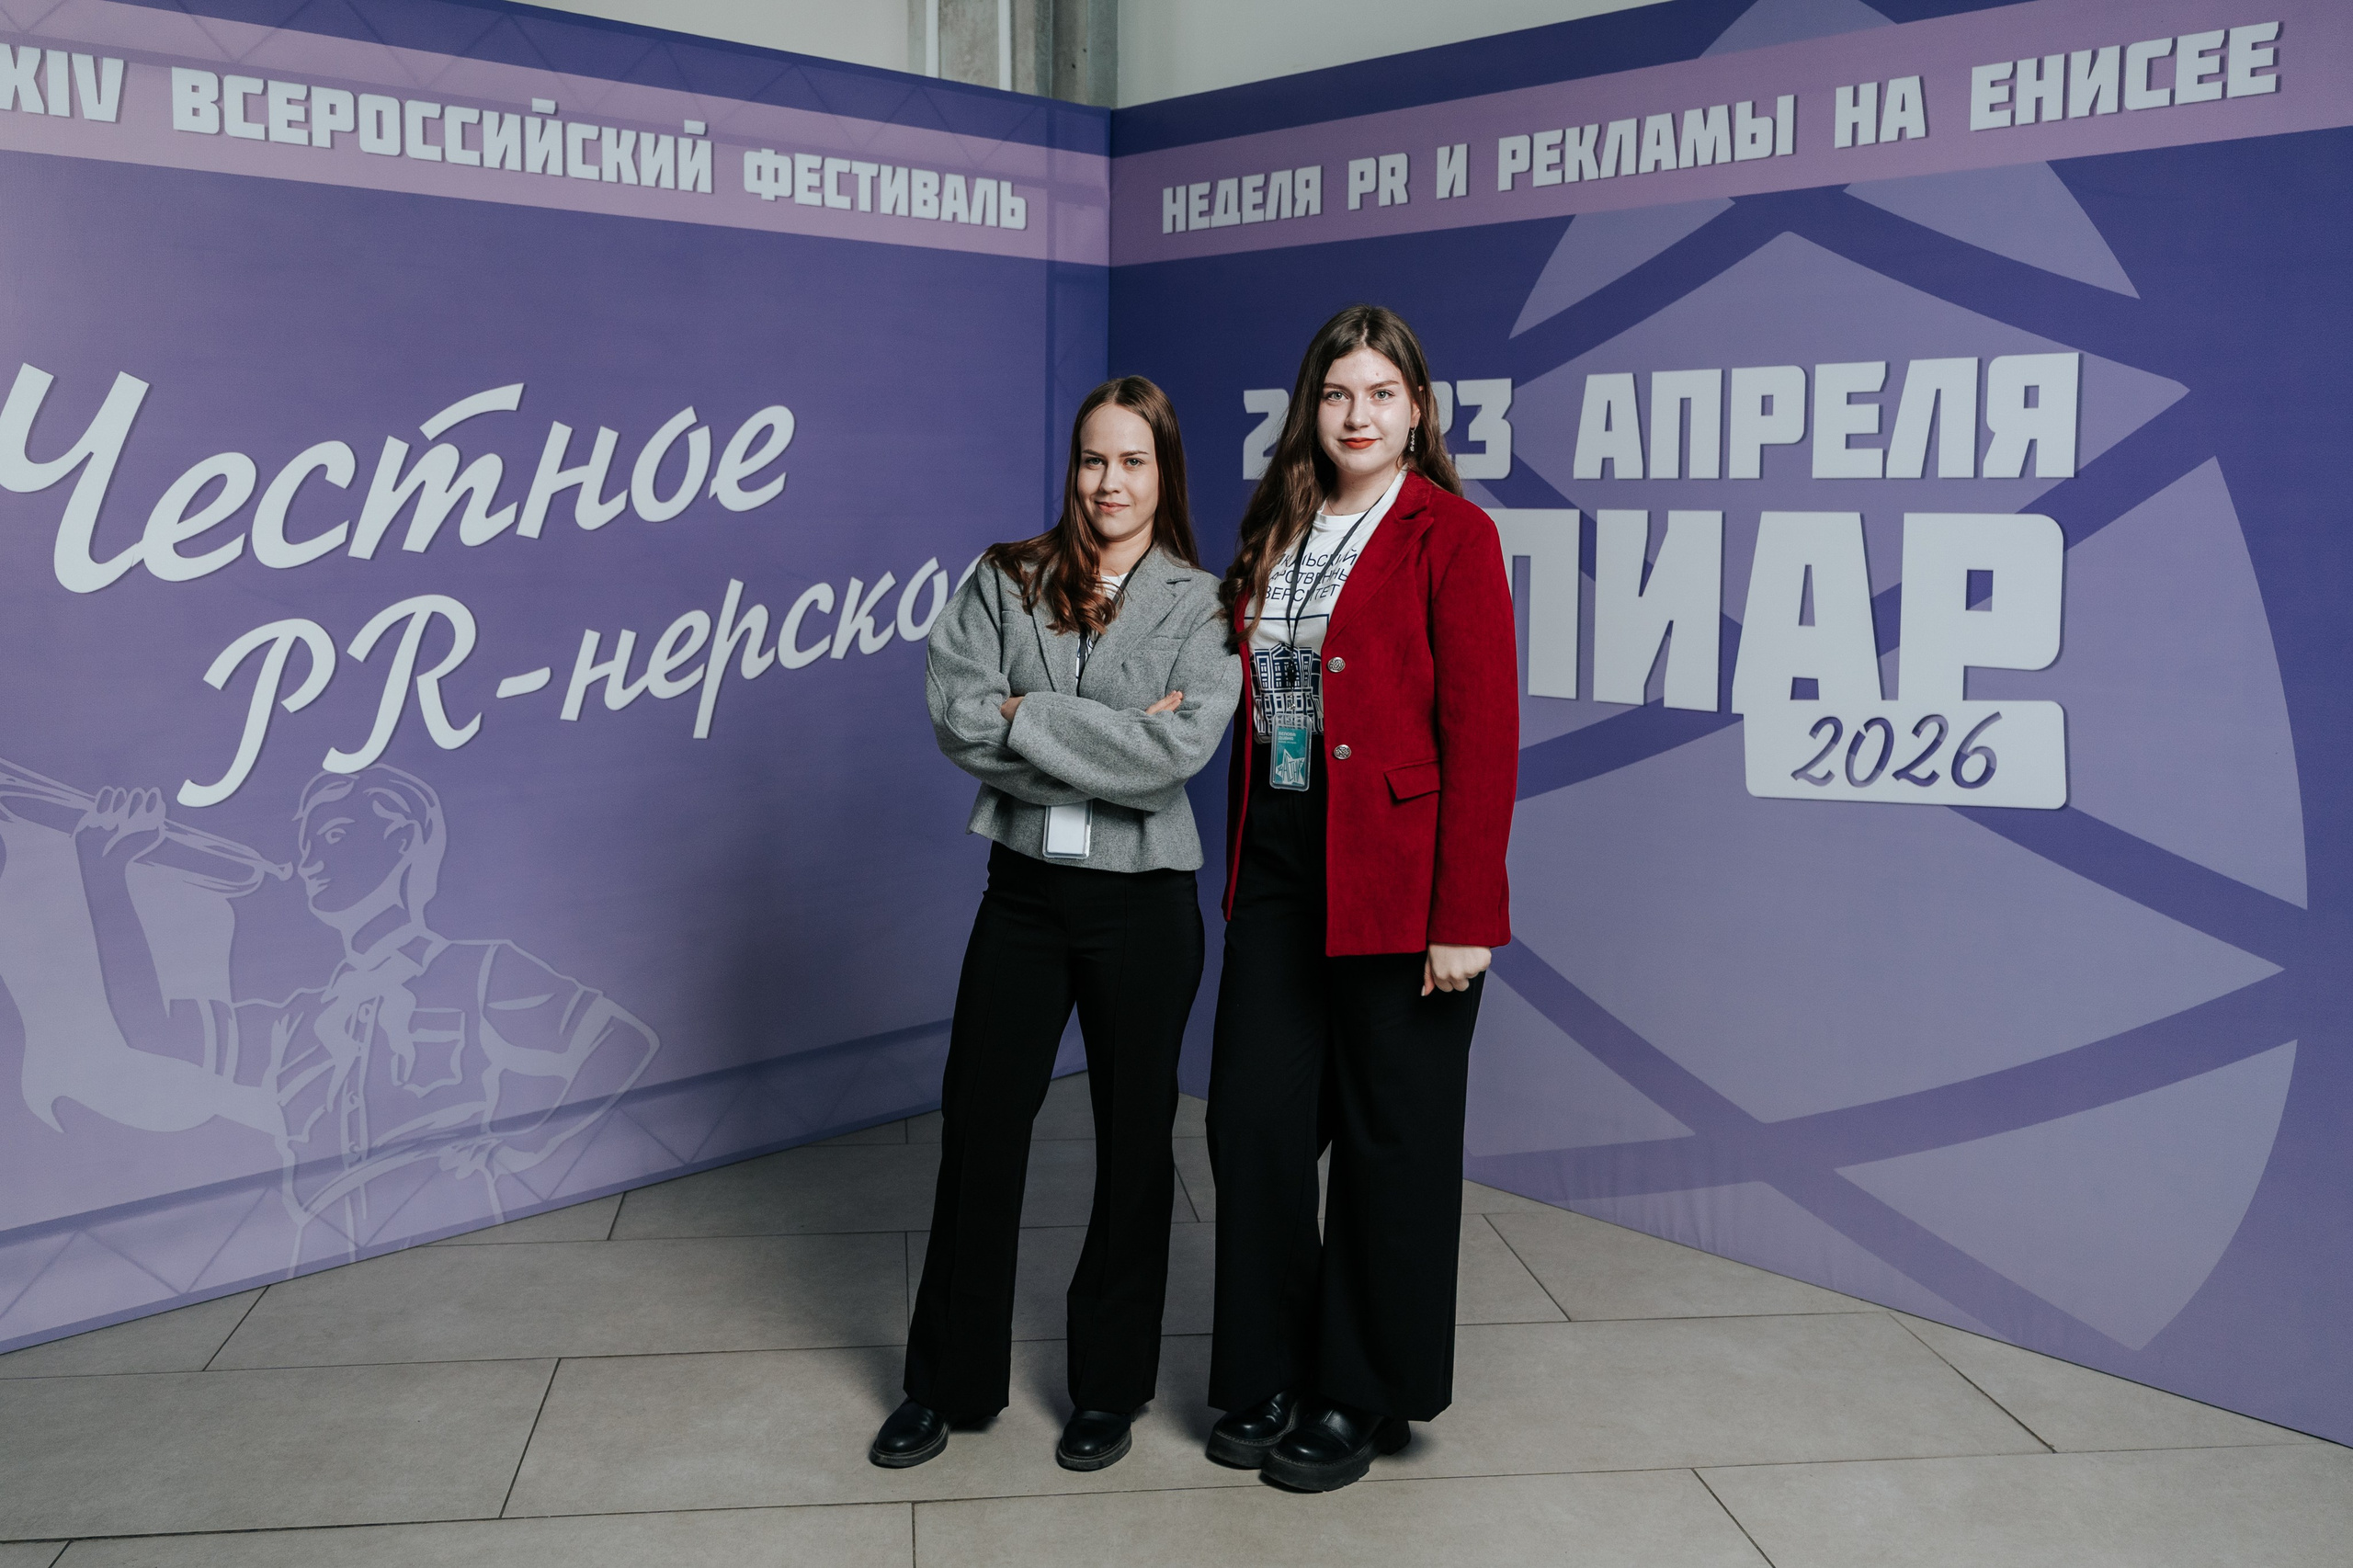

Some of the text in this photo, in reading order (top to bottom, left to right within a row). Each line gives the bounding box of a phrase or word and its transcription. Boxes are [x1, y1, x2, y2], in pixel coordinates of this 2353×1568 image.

[0, 42, 1028, 230] XIV ВСЕРОССИЙСКИЙ ФЕСТИВАЛЬ
[1163, 21, 2279, 234] НЕДЕЛЯ PR И РЕКЛАМЫ НА ЕНИСЕЕ
[0, 362, 796, 594] Честное
[1574, 352, 2080, 479] АПРЕЛЯ
[176, 548, 985, 808] PR-нерско
[1483, 508, 2064, 716] ПИАР
[1790, 711, 2003, 790] 2026
